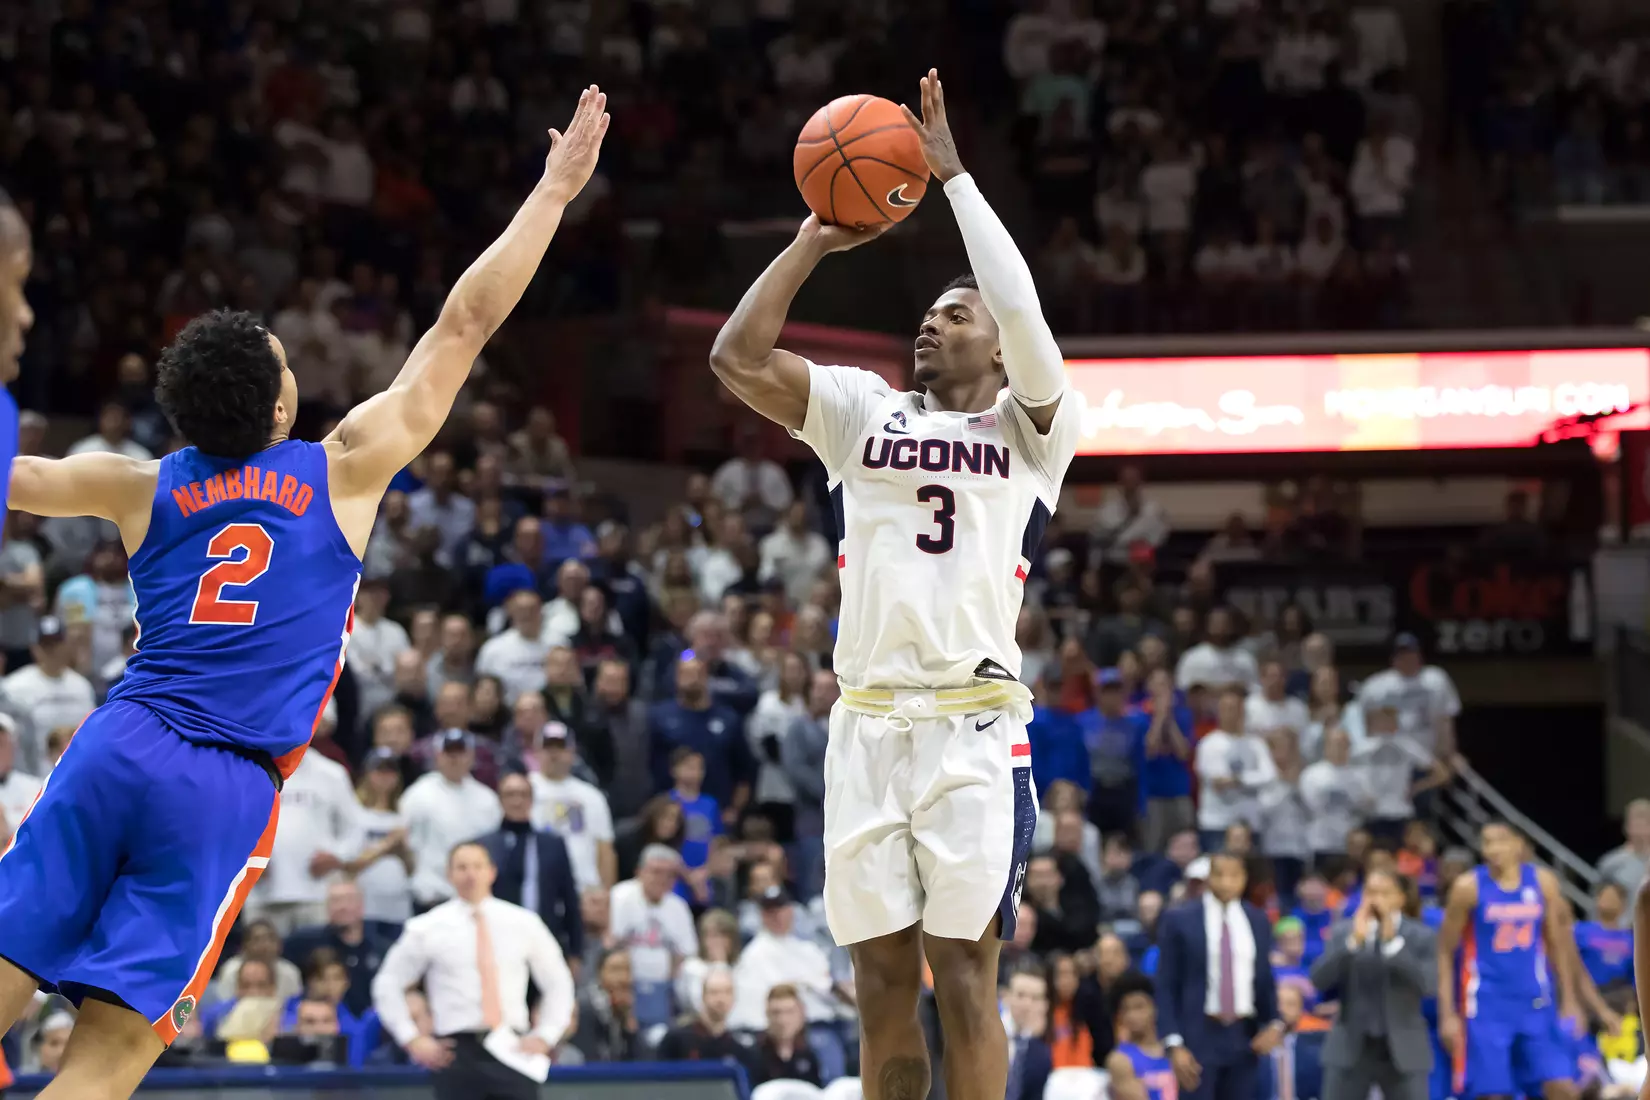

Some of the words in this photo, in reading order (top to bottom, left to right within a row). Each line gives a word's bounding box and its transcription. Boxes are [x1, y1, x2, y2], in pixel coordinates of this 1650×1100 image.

[862, 436, 1010, 479] UCONN
[171, 465, 314, 519] NEMBHARD
[916, 484, 956, 555] 3
[188, 523, 275, 626] 2
[1437, 618, 1545, 652] zero
